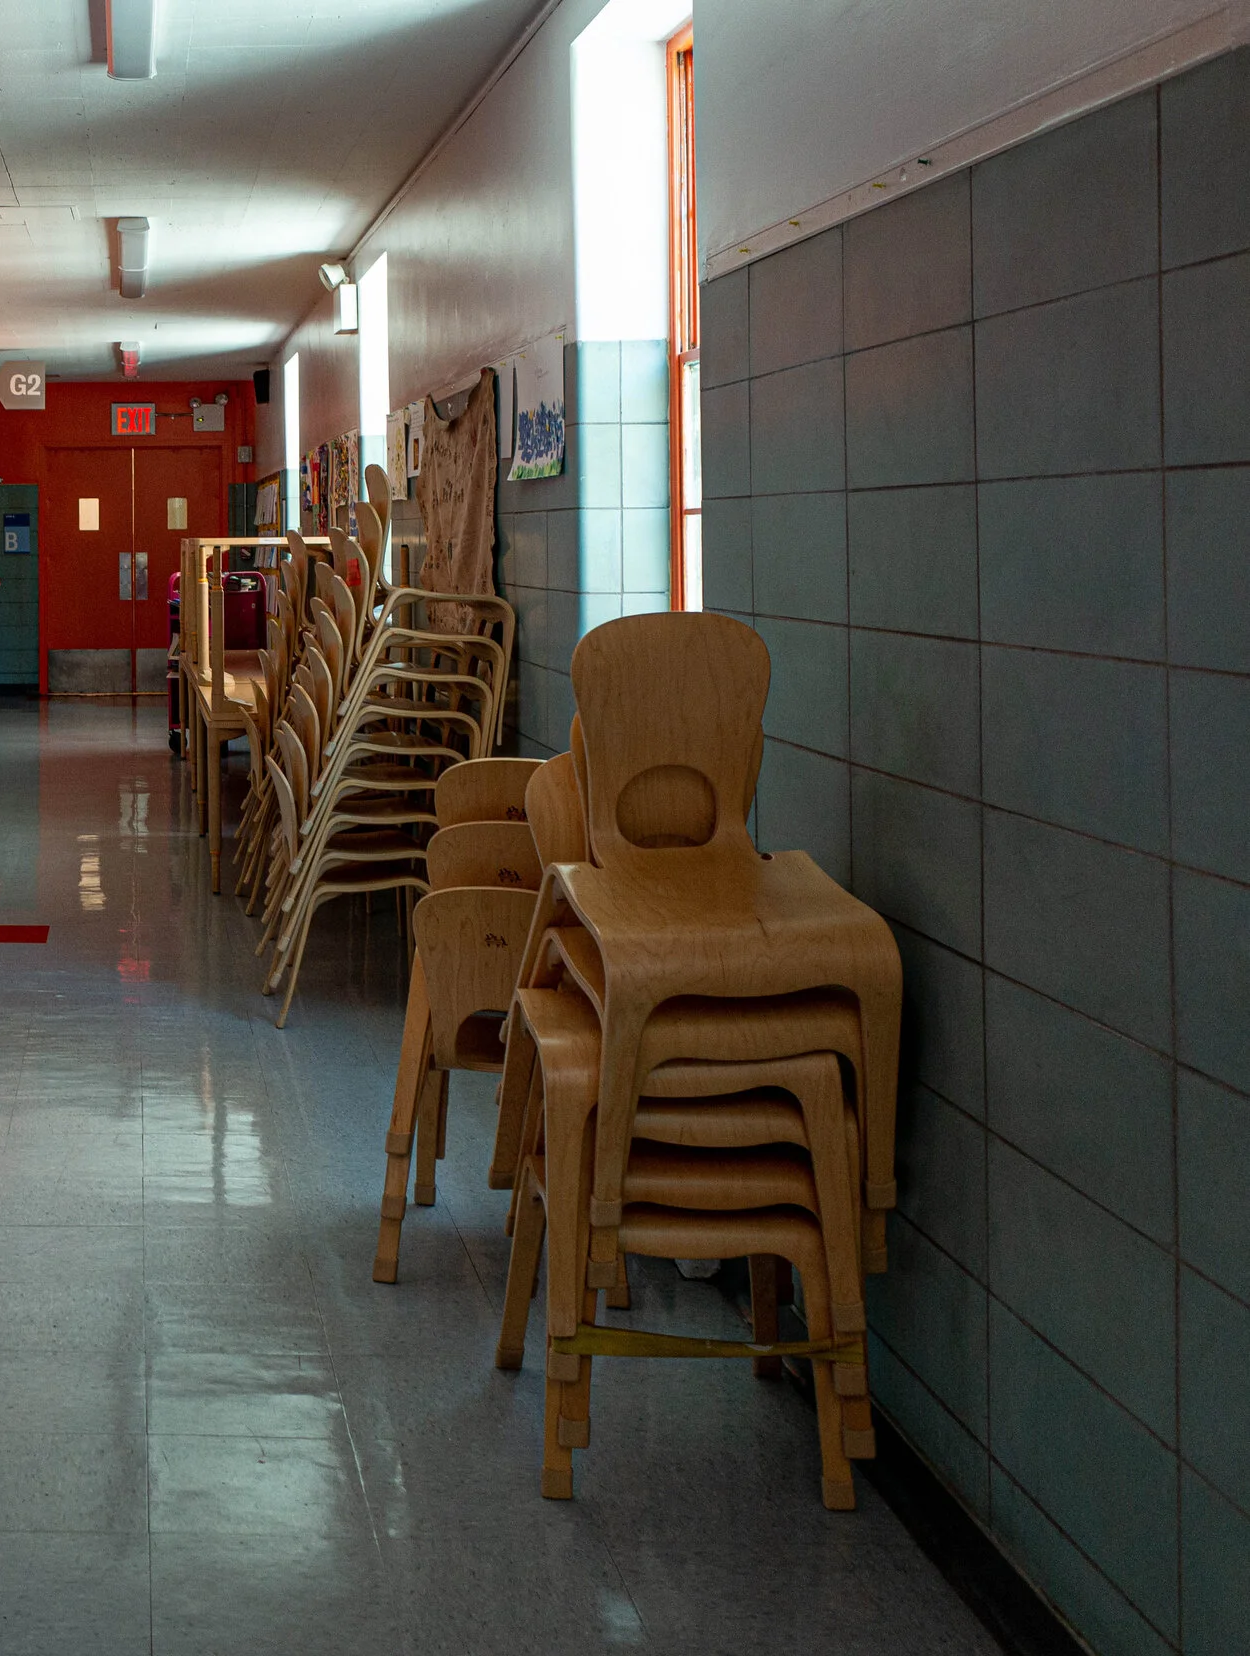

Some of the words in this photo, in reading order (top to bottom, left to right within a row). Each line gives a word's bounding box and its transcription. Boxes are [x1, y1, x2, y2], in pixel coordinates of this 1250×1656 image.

[10, 374, 41, 396] G2
[117, 407, 152, 433] EXIT
[5, 532, 18, 551] B
